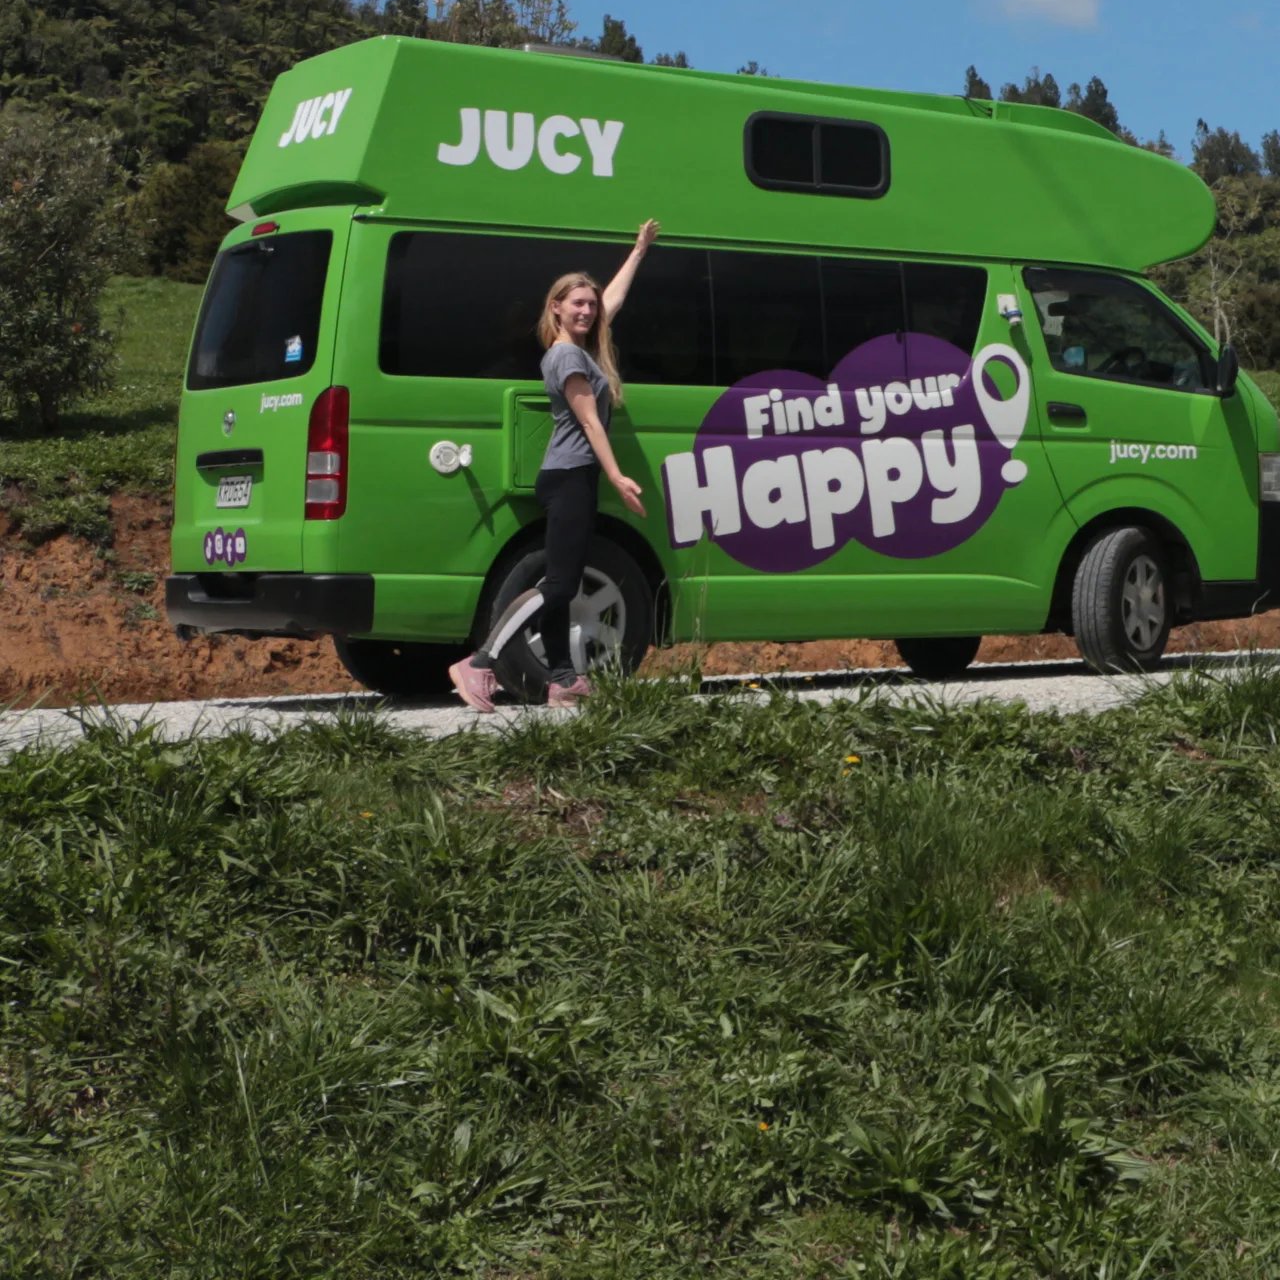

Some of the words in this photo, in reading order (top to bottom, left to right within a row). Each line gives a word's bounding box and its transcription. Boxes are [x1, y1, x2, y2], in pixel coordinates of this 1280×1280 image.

[278, 88, 353, 148] JUCY
[437, 107, 625, 177] JUCY
[260, 392, 303, 414] jucy.com
[743, 383, 845, 440] Find
[854, 373, 962, 435] your
[1109, 439, 1198, 464] jucy.com
